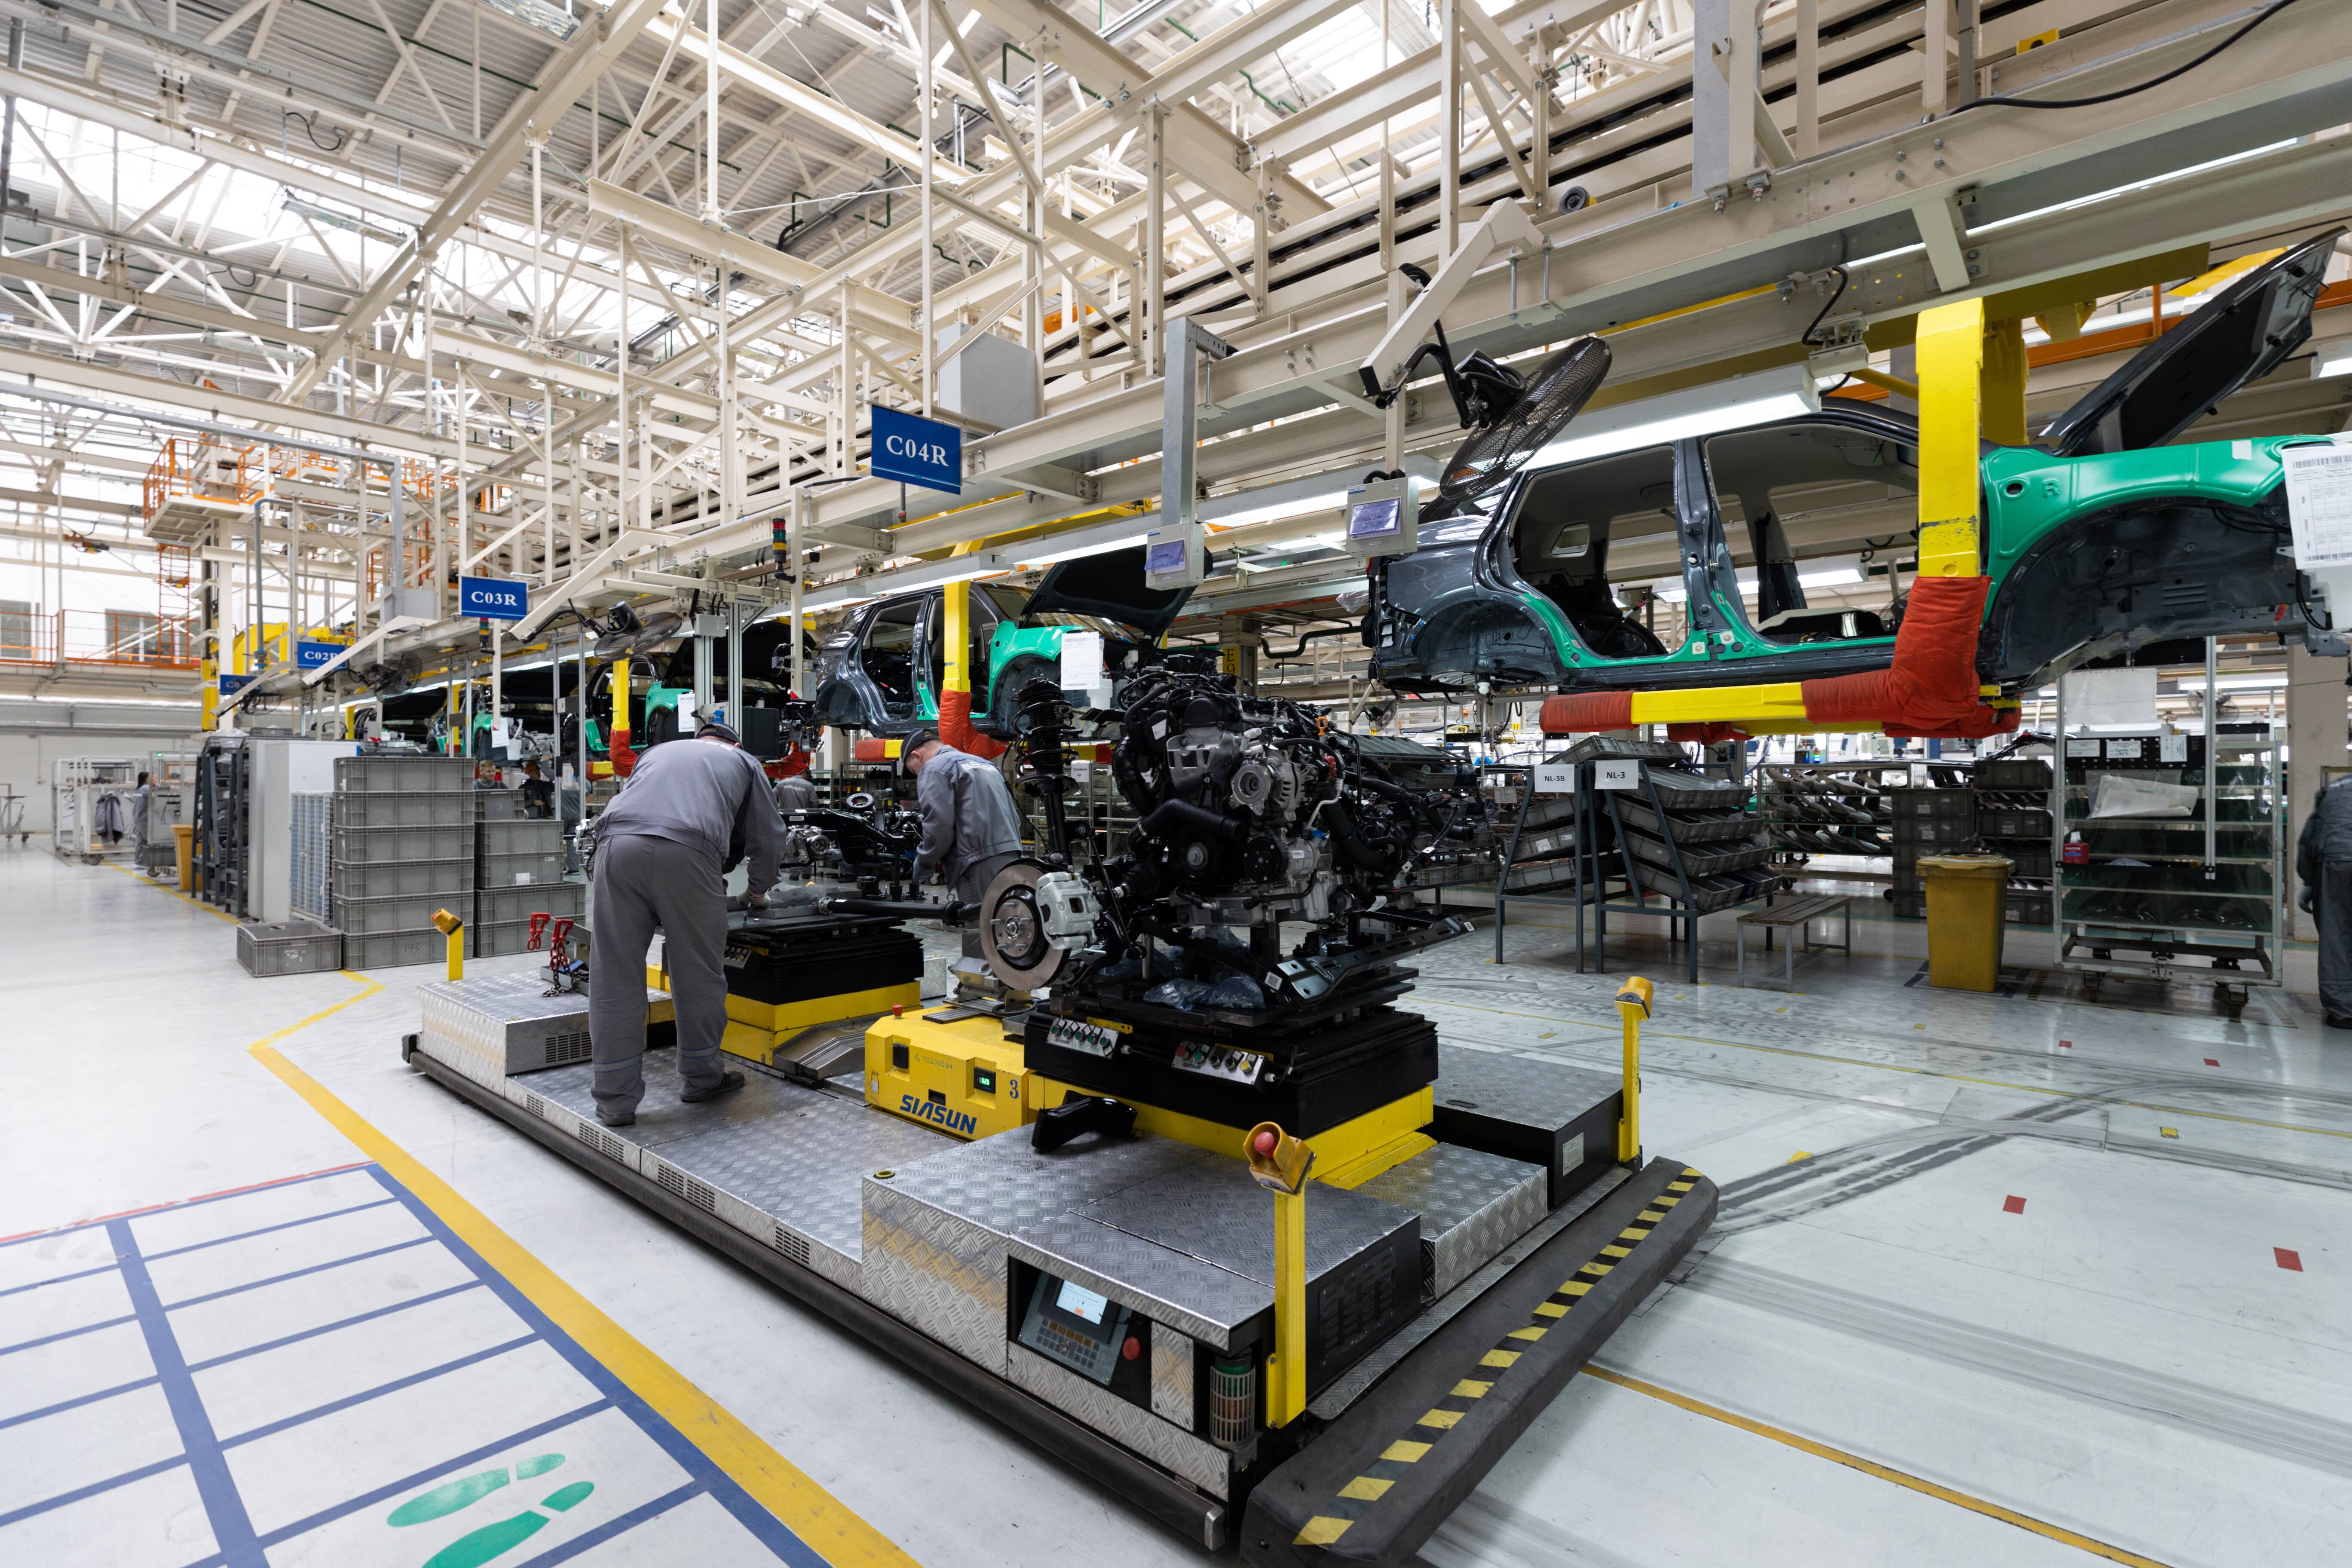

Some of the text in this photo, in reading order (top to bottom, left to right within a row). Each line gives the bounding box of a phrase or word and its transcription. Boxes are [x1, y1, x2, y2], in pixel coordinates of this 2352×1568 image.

[886, 435, 949, 467] C04R
[471, 591, 518, 606] C03R
[404, 943, 420, 955] 143
[1009, 1079, 1019, 1099] 3
[900, 1094, 977, 1135] SIASUN
